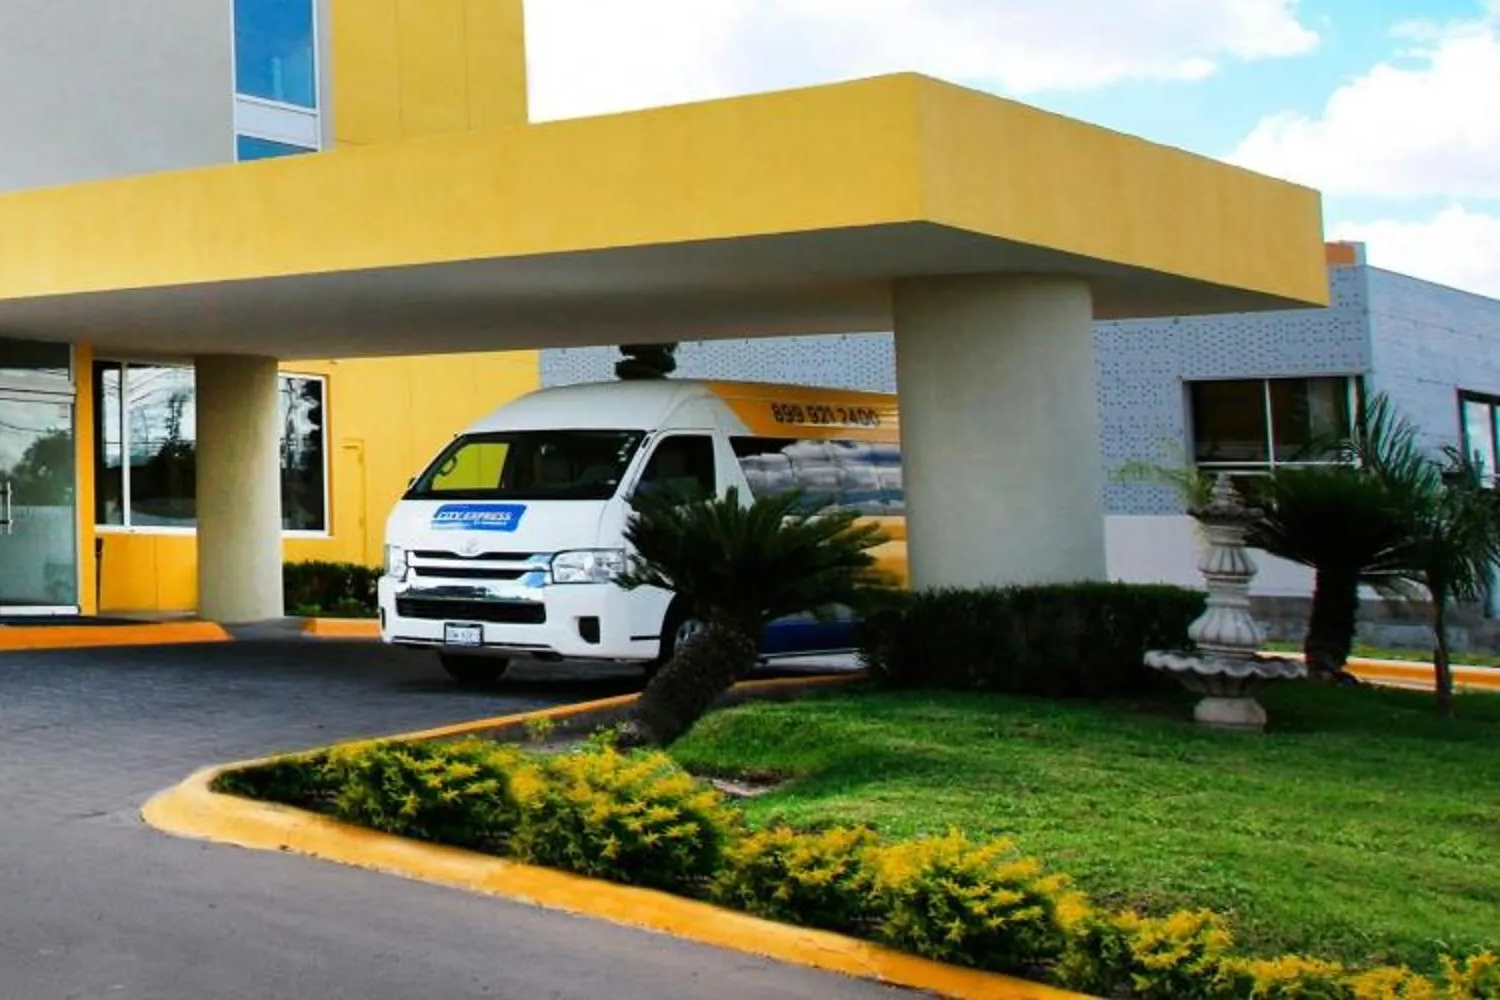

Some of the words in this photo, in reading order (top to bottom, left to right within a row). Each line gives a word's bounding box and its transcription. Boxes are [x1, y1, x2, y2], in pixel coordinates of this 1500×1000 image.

[771, 402, 805, 424] 899
[438, 511, 463, 521] CITY
[463, 511, 512, 521] EXPRESS
